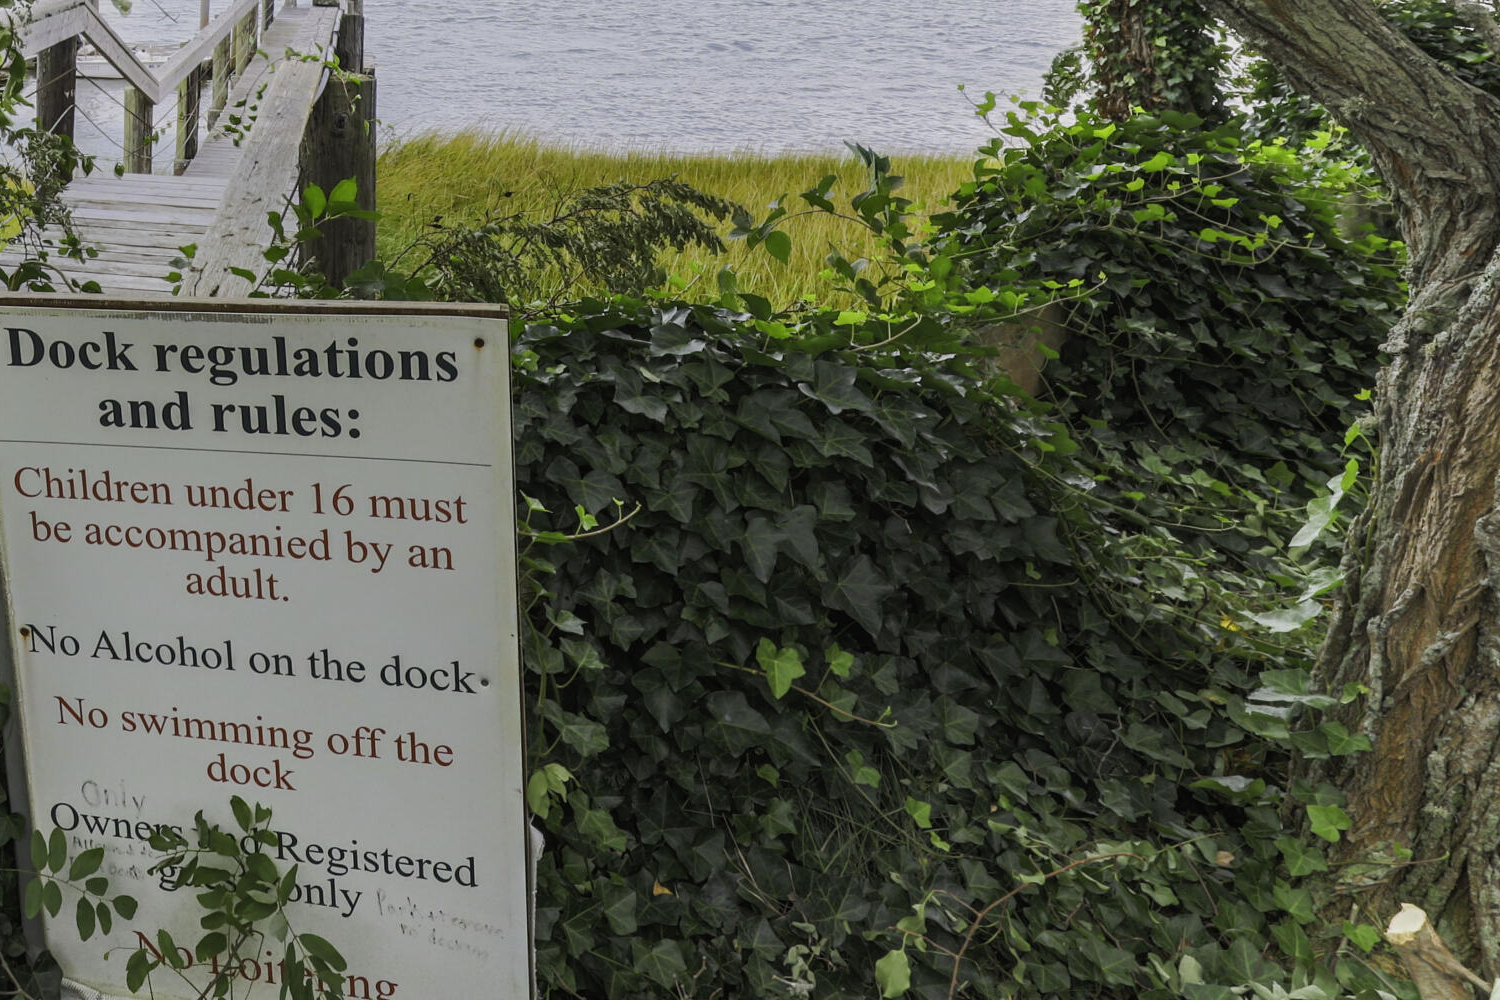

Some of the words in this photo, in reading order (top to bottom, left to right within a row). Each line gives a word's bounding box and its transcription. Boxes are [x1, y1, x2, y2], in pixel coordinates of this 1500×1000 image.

[4, 327, 140, 372] Dock
[152, 335, 459, 387] regulations
[98, 390, 194, 431] and
[210, 394, 361, 439] rules:
[13, 466, 173, 506] Children
[183, 477, 295, 513] under
[310, 482, 355, 517] 16
[368, 495, 469, 525] must
[30, 510, 72, 544] be
[84, 523, 333, 563] accompanied
[343, 529, 394, 574] by
[407, 544, 456, 571] an
[186, 565, 289, 603] adult.
[28, 623, 81, 657] No
[89, 629, 237, 672] Alcohol
[248, 651, 297, 677] on
[306, 648, 366, 684] the
[379, 654, 478, 695] dock
[55, 695, 109, 729] No
[121, 706, 315, 759] swimming
[327, 726, 387, 759] off
[393, 731, 454, 767] the
[206, 753, 297, 792] dock
[273, 830, 480, 887] Registered
